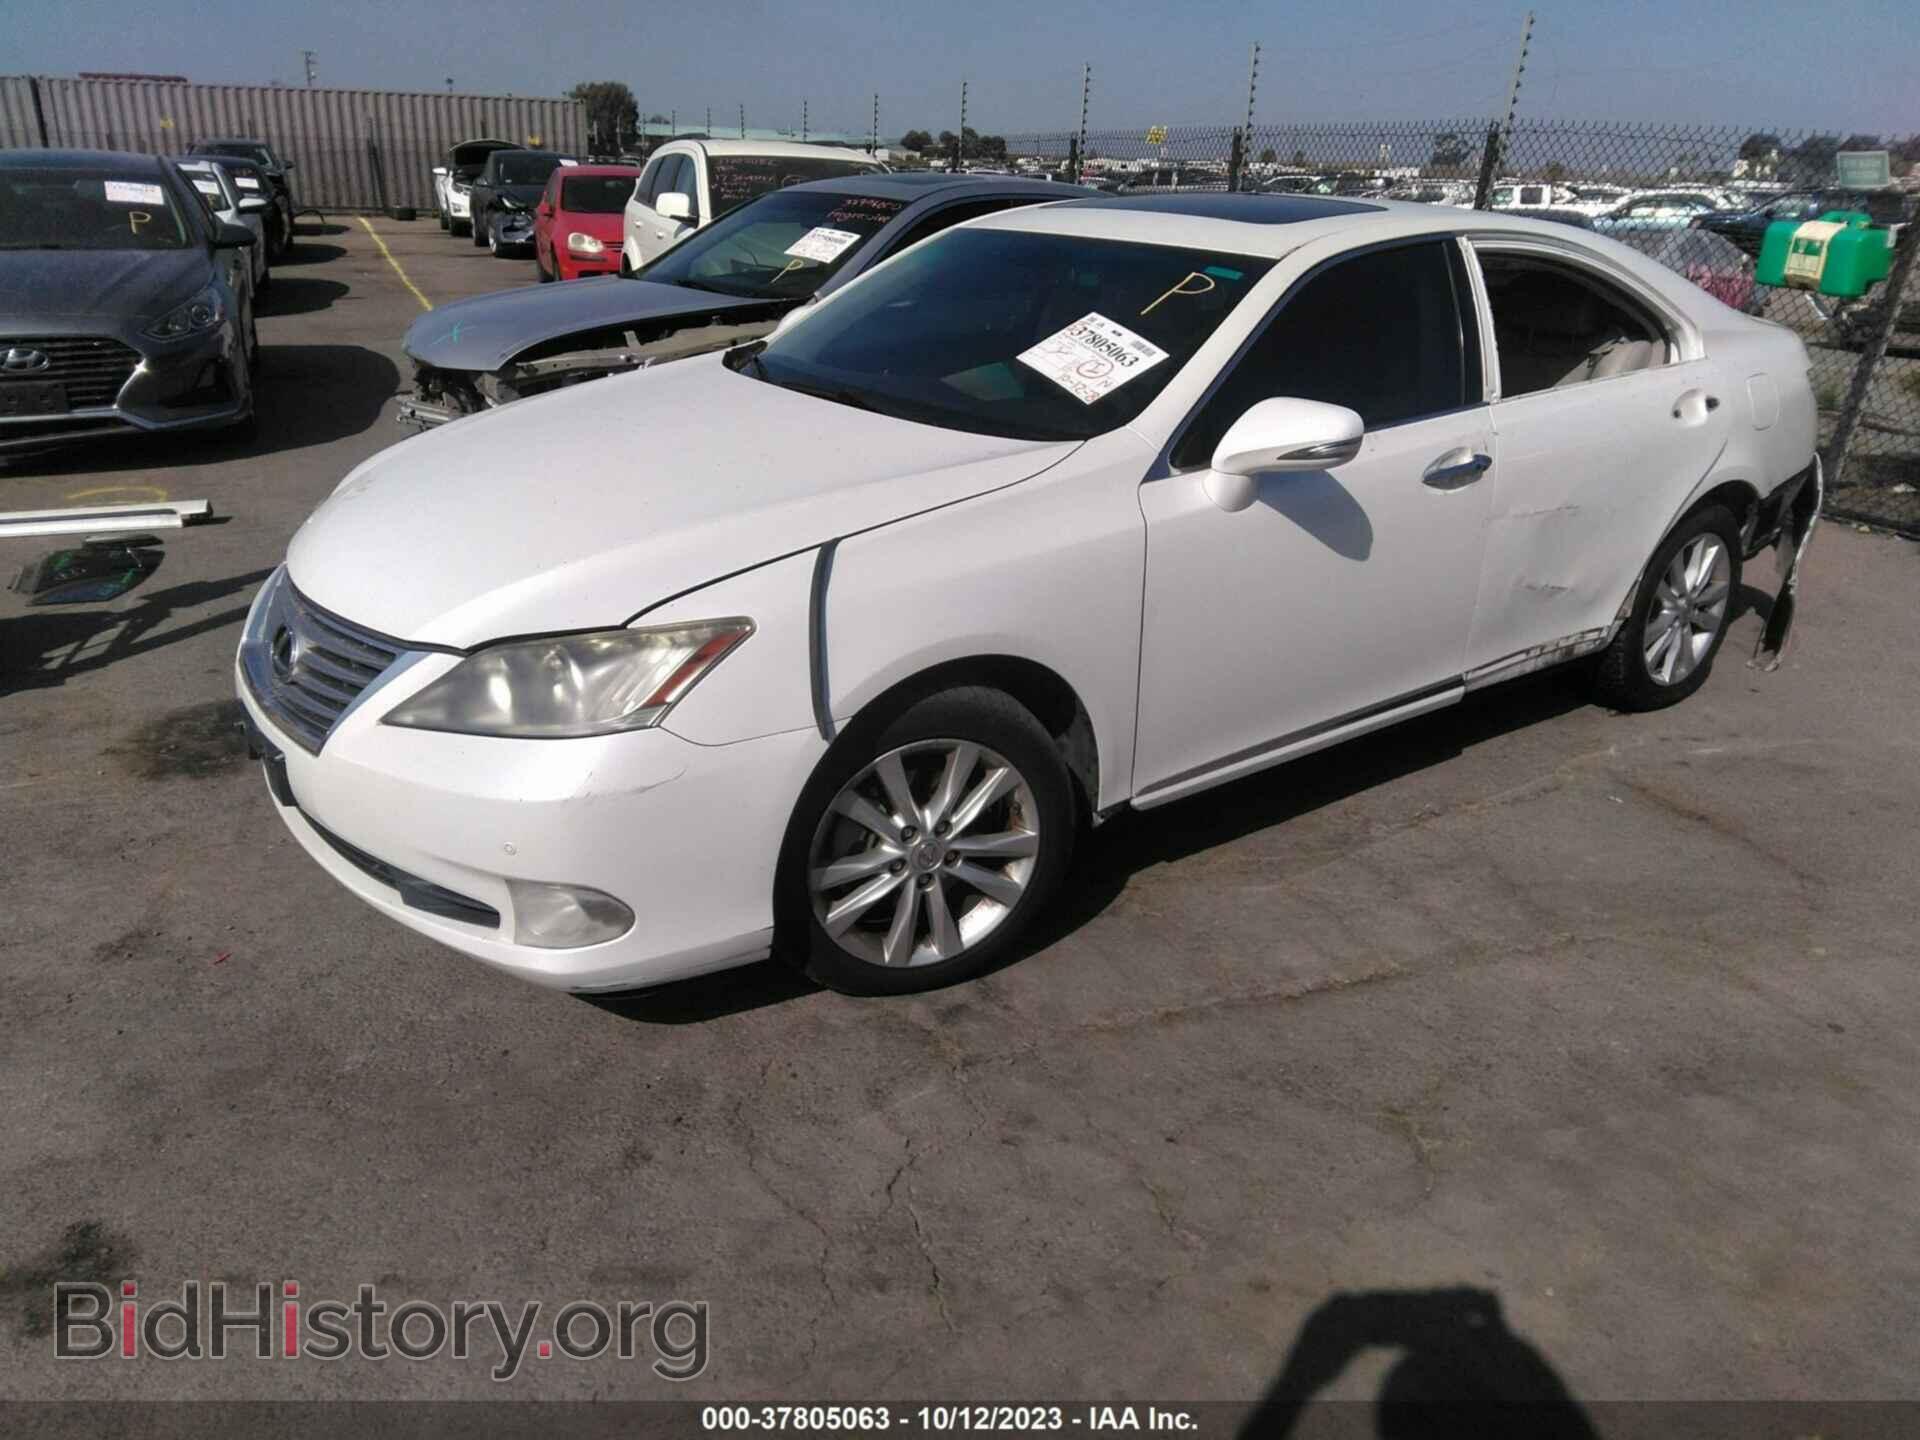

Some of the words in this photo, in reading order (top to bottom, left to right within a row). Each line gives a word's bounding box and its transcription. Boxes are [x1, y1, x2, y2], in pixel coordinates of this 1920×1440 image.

[129, 211, 151, 234] P
[770, 259, 804, 284] P
[1140, 272, 1215, 315] P
[1070, 326, 1139, 367] 37805063
